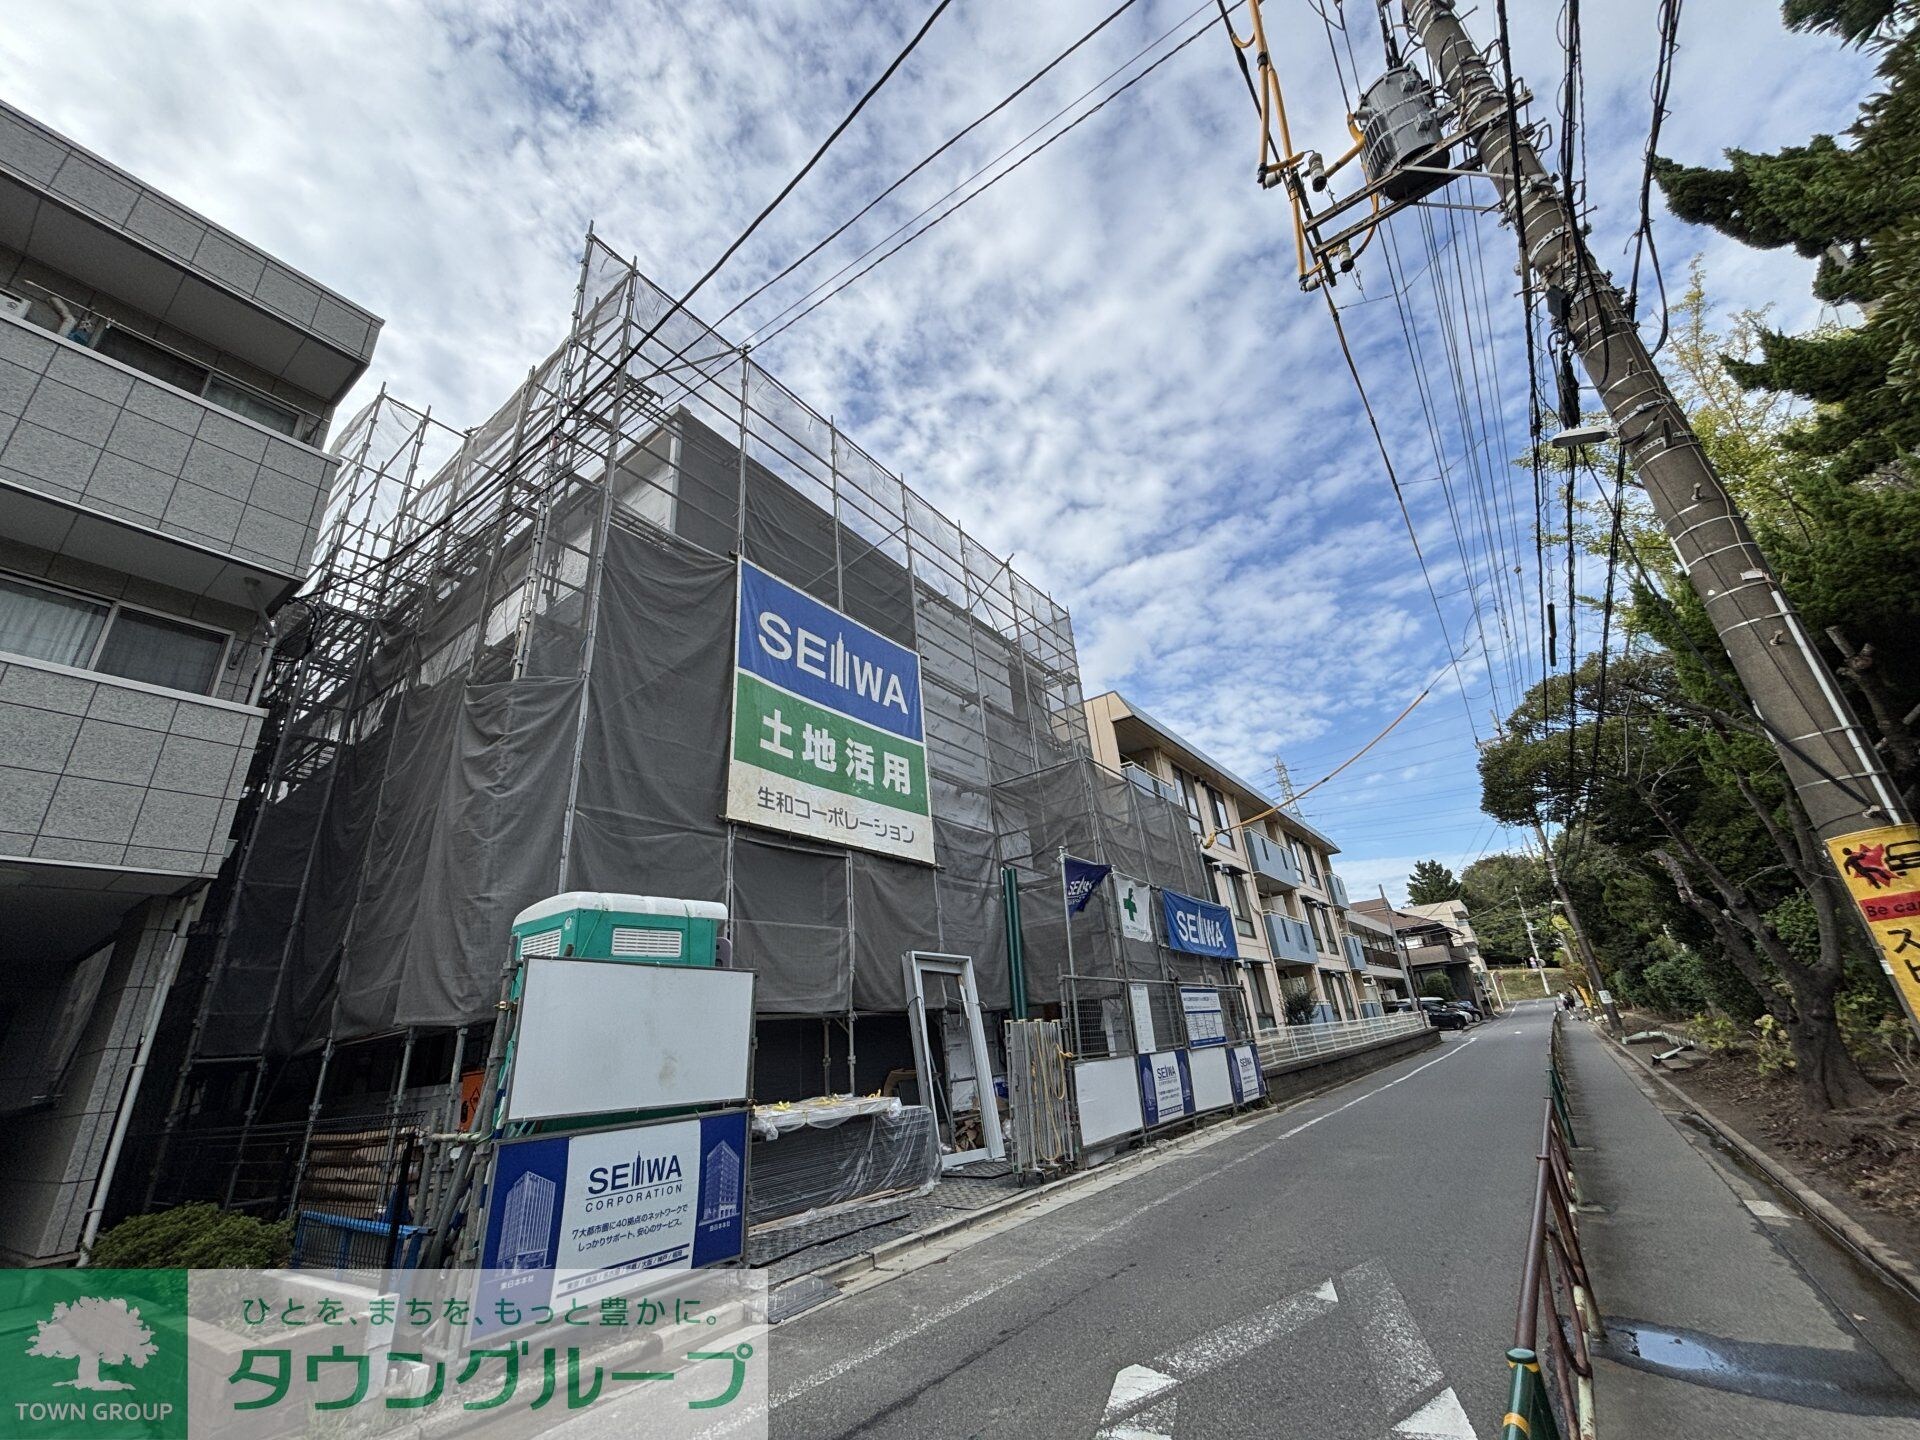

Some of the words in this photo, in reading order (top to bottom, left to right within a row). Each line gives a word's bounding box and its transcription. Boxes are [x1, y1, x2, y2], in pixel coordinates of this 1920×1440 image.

[757, 610, 909, 715] SEIWA
[759, 708, 912, 795] 土地活用
[757, 785, 915, 843] 生和コーポレーション
[1176, 906, 1227, 949] SEIWA
[1865, 905, 1888, 916] Be
[588, 1151, 682, 1194] SEIWA
[585, 1184, 683, 1213] CORPORATION
